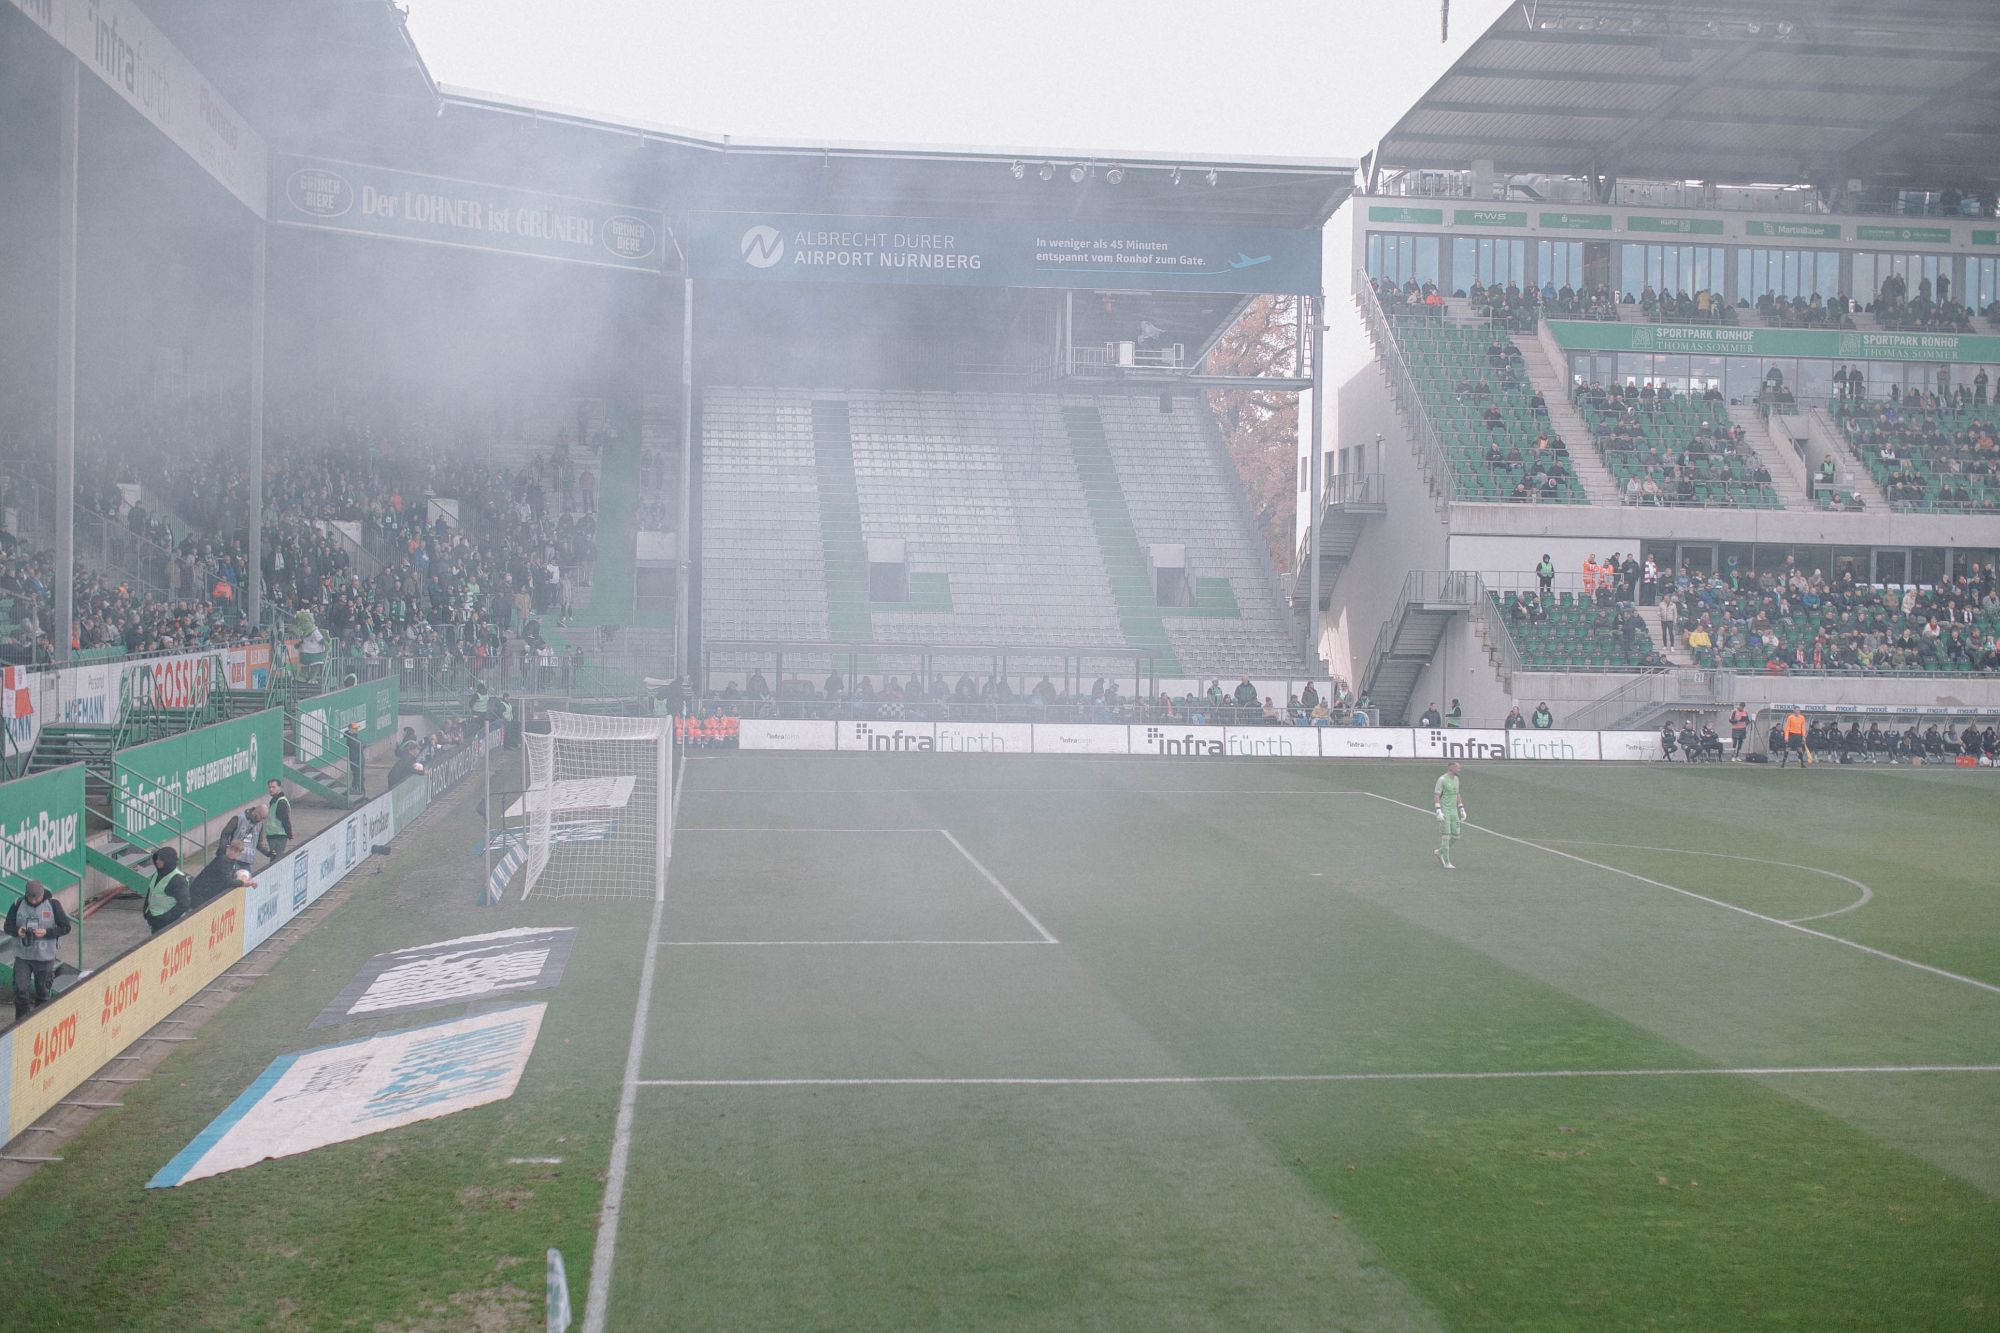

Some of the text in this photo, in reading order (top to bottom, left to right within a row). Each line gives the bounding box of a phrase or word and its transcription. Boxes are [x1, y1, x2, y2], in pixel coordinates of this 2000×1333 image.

[306, 191, 335, 209] BIERE
[362, 185, 594, 245] Der LOHNER ist GRÜNER!
[1474, 212, 1507, 220] RWS
[612, 221, 645, 240] GRÜNER
[794, 231, 888, 247] ALBRECHT
[1778, 225, 1825, 235] MartinBauer
[617, 236, 641, 252] BIERE
[1036, 237, 1168, 251] In weniger als 45 Minuten
[793, 251, 981, 269] AIRPORT NÜRNBERG
[1036, 252, 1206, 266] entspannt vom Ronhof zum Gate.
[1656, 327, 1754, 341] SPORTPARK RONHOF
[1863, 334, 1959, 348] SPORTPARK RONHOF
[1656, 341, 1754, 353] THOMAS SOMMER
[1863, 347, 1959, 360] THOMAS SOMMER
[232, 662, 244, 684] OBI
[153, 658, 209, 708] GOSSLER
[186, 765, 205, 794] SPVGG
[205, 756, 232, 786] GREUTHER
[233, 747, 249, 776] FÜRTH
[217, 907, 236, 942] LOTTO
[170, 936, 193, 977] LOTTO
[113, 971, 140, 1017] LOTTO
[44, 1012, 77, 1067] LOTTO
